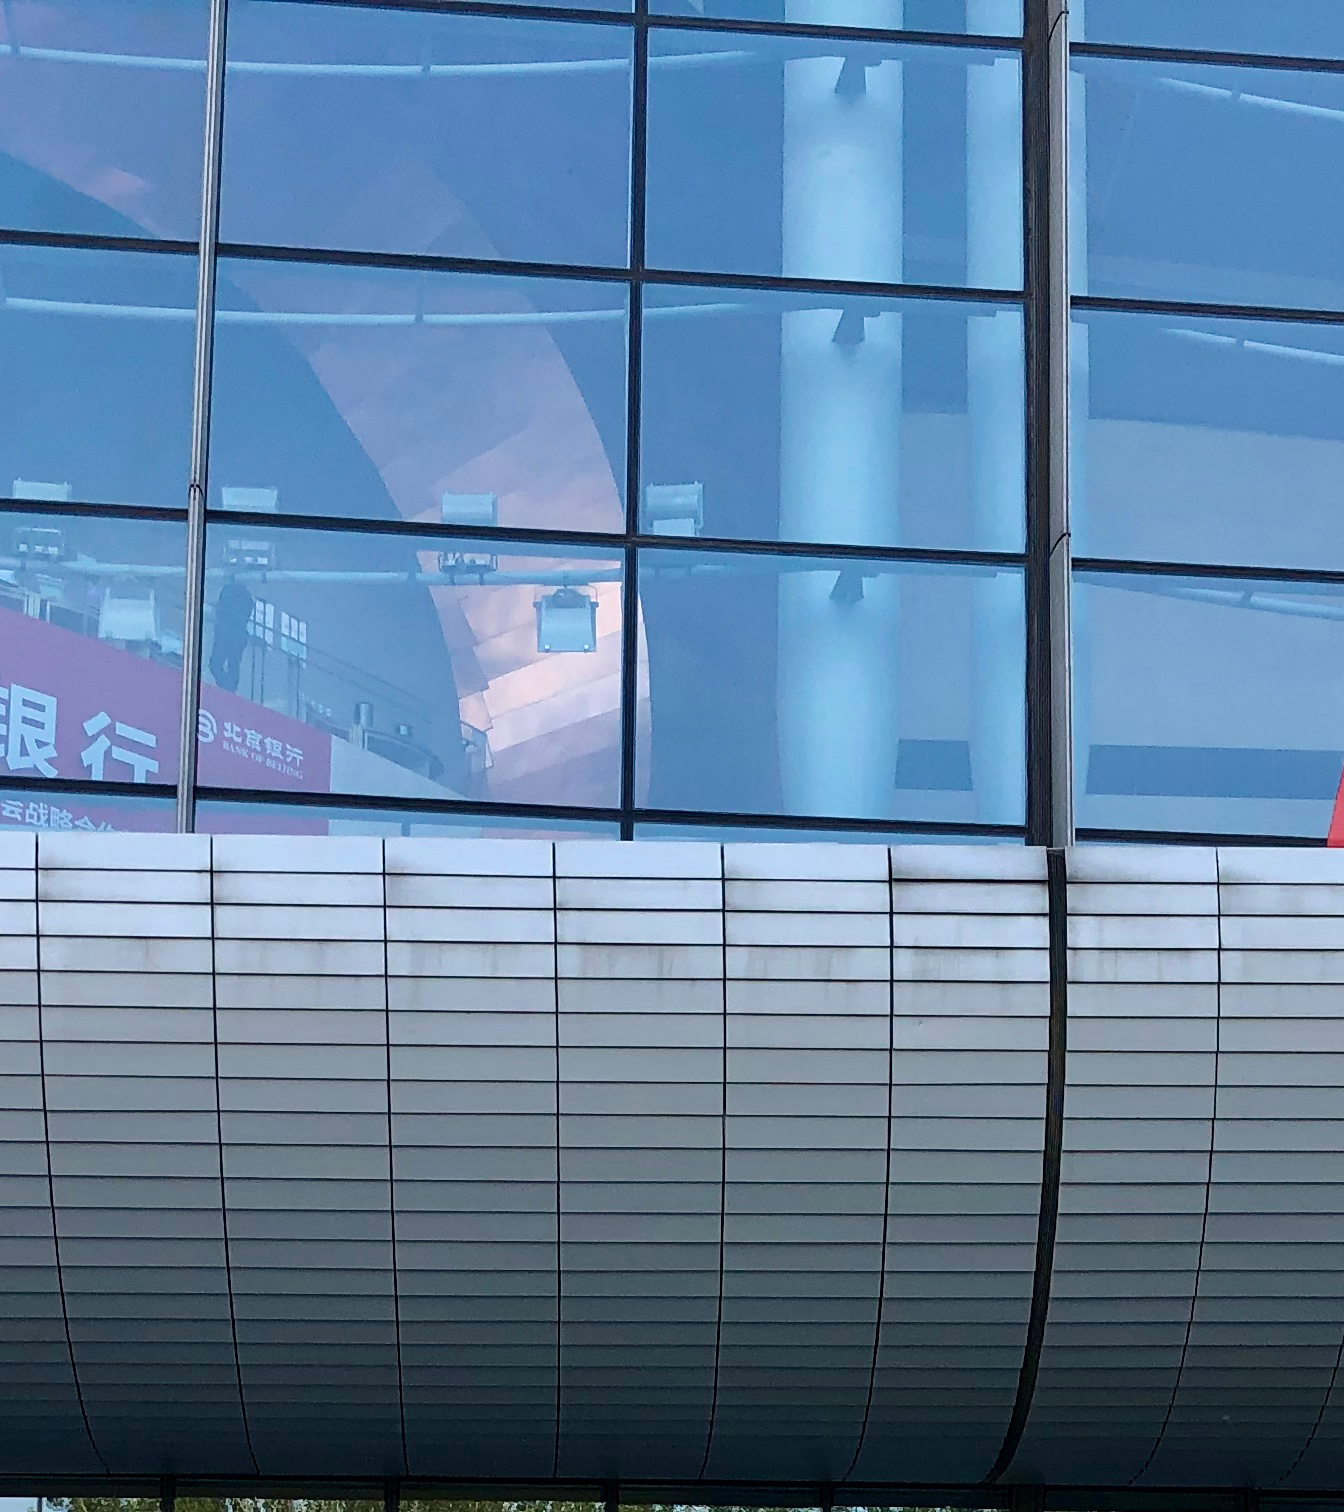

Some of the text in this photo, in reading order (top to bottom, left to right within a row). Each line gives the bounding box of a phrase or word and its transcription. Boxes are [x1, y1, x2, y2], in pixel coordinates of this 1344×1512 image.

[221, 740, 250, 760] BANK
[222, 720, 305, 768] 北京银行
